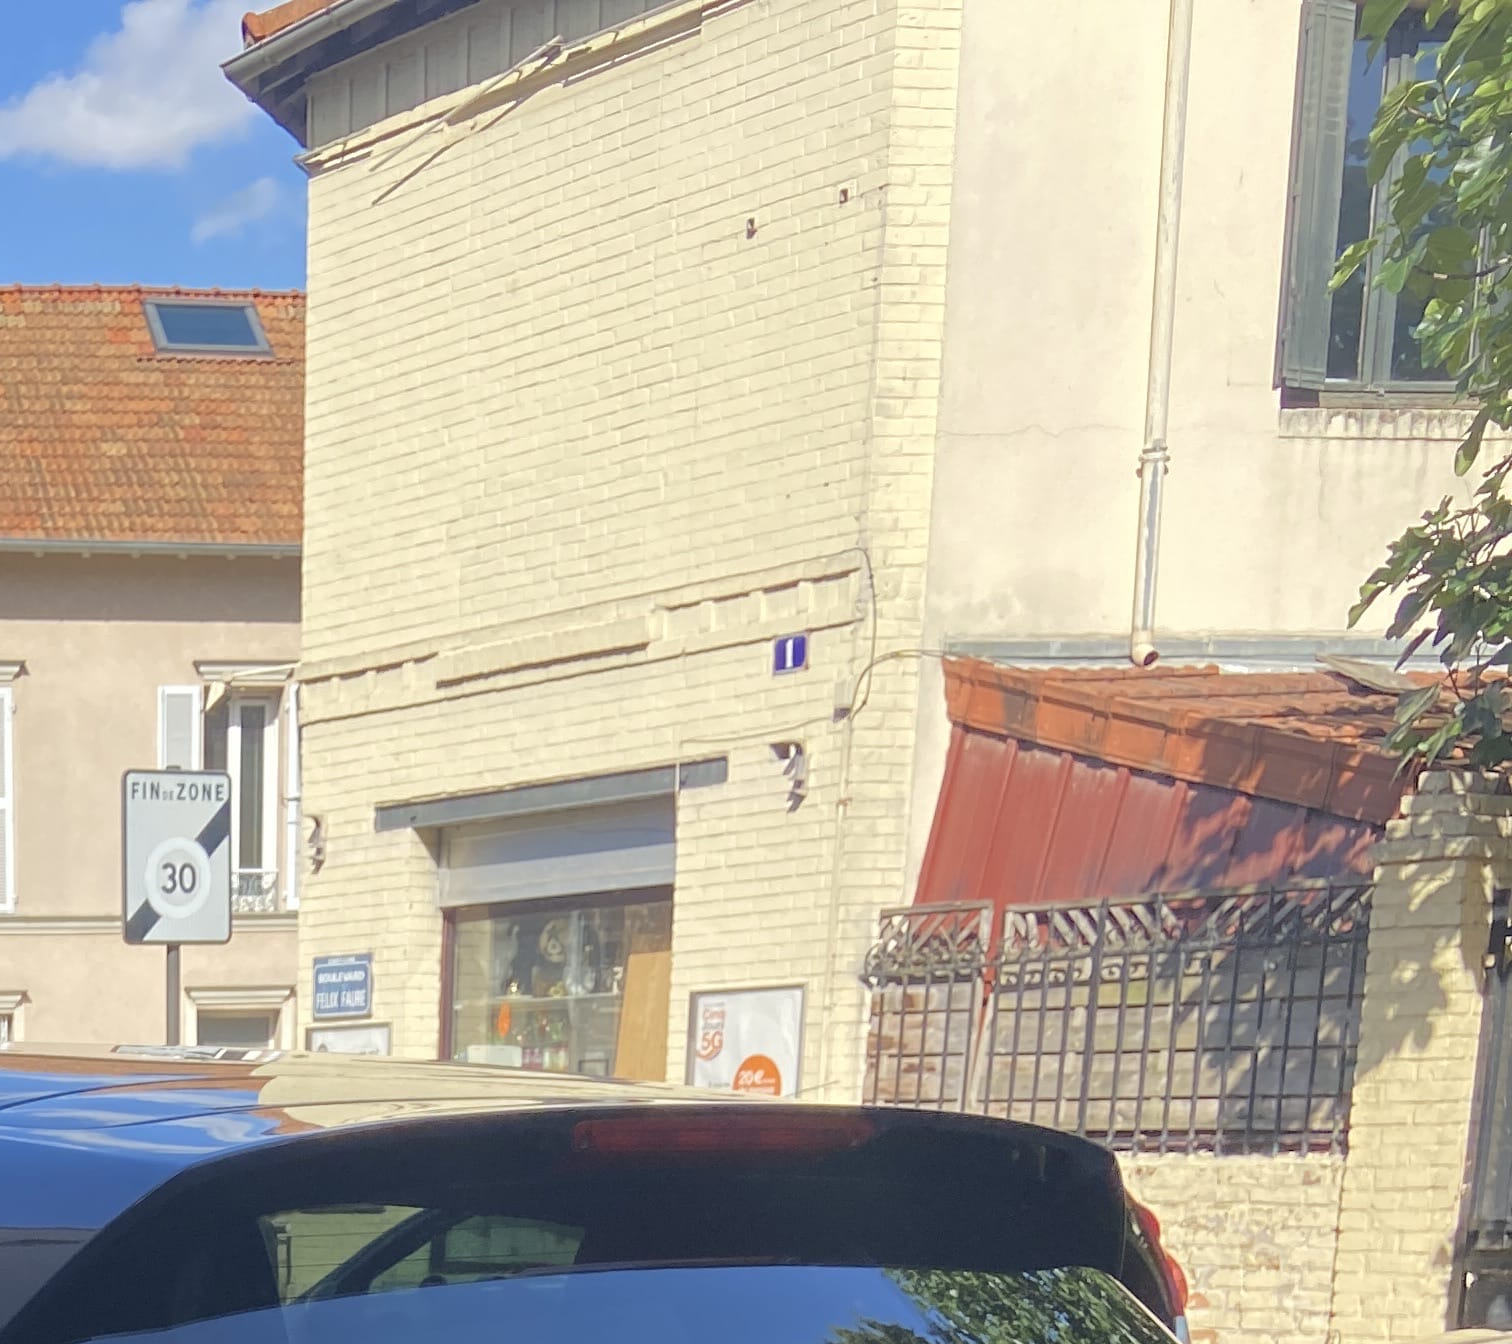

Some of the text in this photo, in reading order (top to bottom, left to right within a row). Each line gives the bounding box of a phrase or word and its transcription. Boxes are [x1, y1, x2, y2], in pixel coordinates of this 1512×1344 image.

[131, 782, 160, 800] FIN
[176, 783, 225, 801] ZONE
[161, 862, 197, 894] 30
